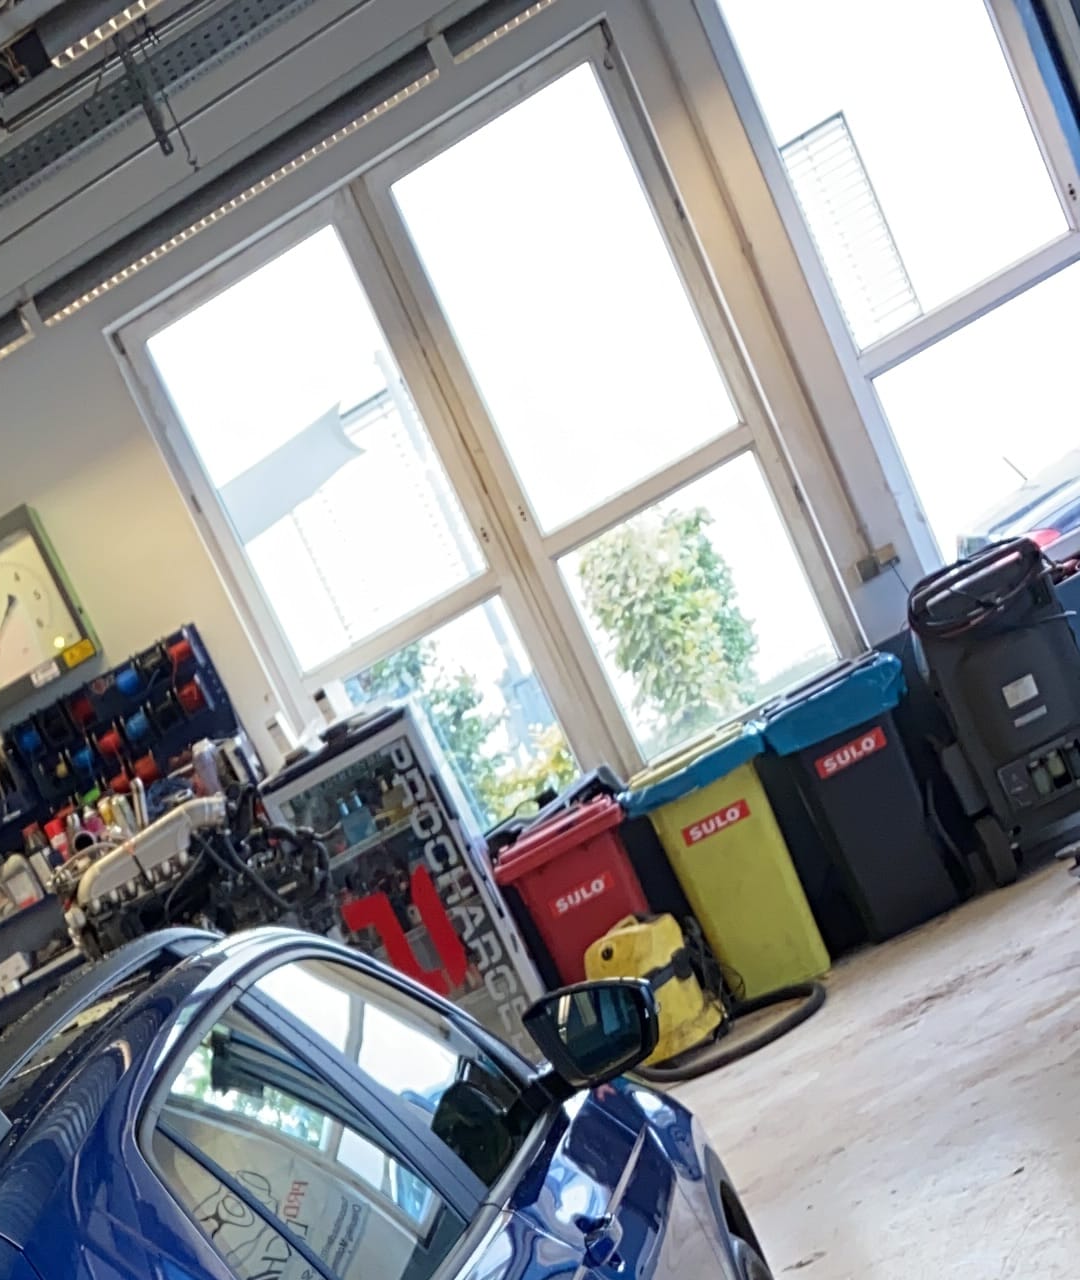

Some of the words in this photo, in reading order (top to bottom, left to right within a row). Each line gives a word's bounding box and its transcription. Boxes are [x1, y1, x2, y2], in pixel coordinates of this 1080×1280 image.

[823, 735, 876, 772] SULO
[688, 806, 741, 842] SULO
[379, 735, 537, 1059] PROCHARGE
[555, 878, 605, 914] SULO
